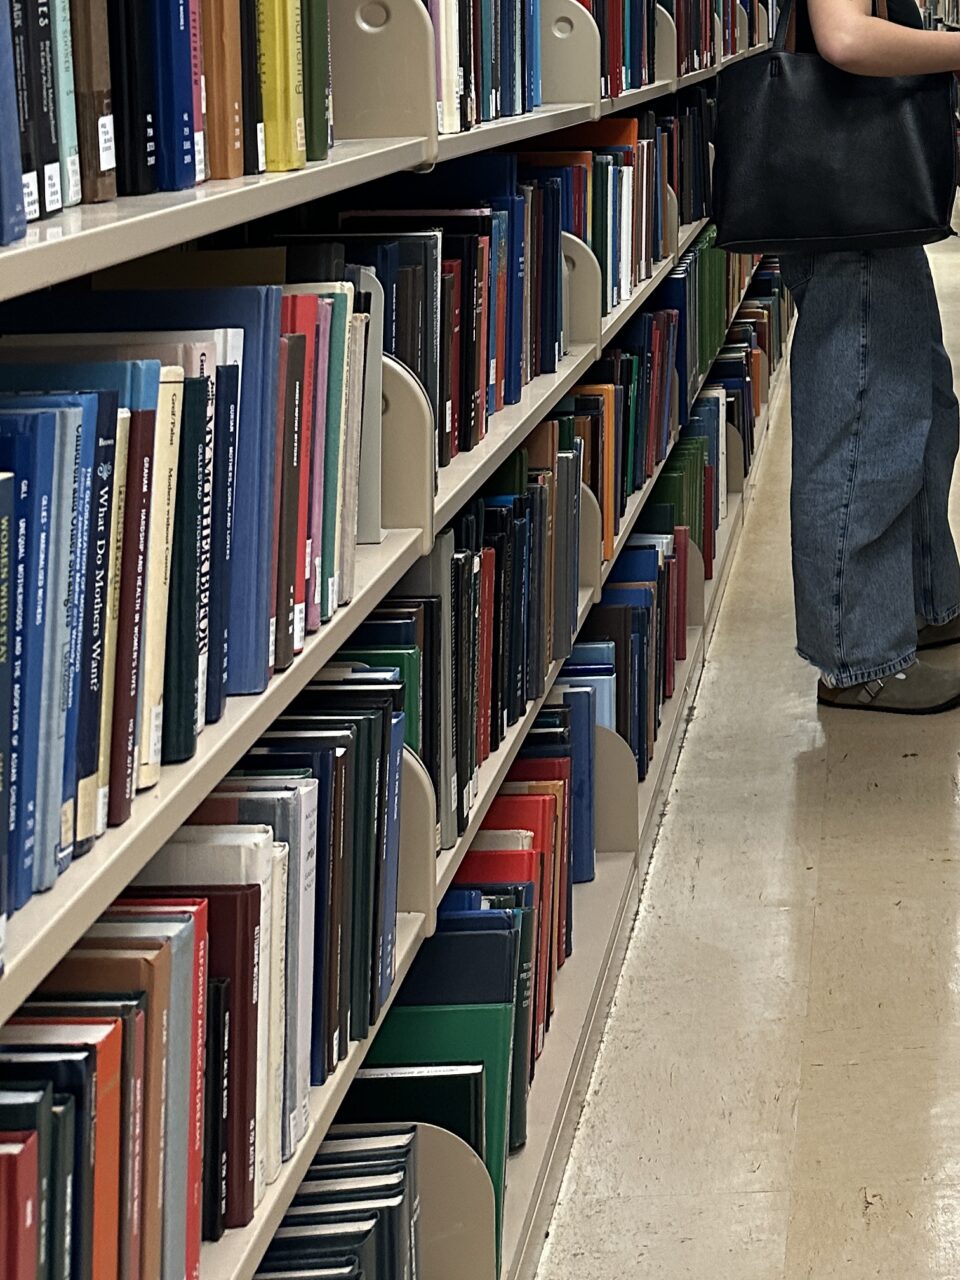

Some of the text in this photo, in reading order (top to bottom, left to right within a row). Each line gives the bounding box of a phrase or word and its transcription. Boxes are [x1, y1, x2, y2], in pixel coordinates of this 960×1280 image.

[45, 40, 57, 144] Redefining Motherhood
[169, 392, 178, 446] Greif/Pabst
[20, 479, 28, 499] GILL
[165, 467, 173, 506] Mothers
[0, 515, 9, 578] WOMEN
[17, 517, 26, 559] UNEQUAL
[81, 489, 91, 574] GLOBALIZATION
[139, 508, 147, 552] HARDSHIP
[38, 532, 47, 587] MARGINALISED
[162, 546, 170, 586] Custody
[0, 582, 8, 620] WHO
[15, 563, 25, 631] MOTHERHOODS
[36, 588, 44, 626] MOTHERS
[89, 485, 109, 692] What Do Mothers Want?
[135, 575, 143, 610] HEALTH
[14, 635, 22, 655] AND
[75, 593, 86, 673] MOTHERHOOD
[131, 625, 139, 673] WOMEN'S
[13, 659, 21, 678] THE
[12, 683, 21, 732] ADOPTION
[10, 752, 18, 782] ASIAN
[8, 785, 16, 832] CHILDREN
[194, 939, 205, 1150] REFORMED AMERICAN DREAMS
